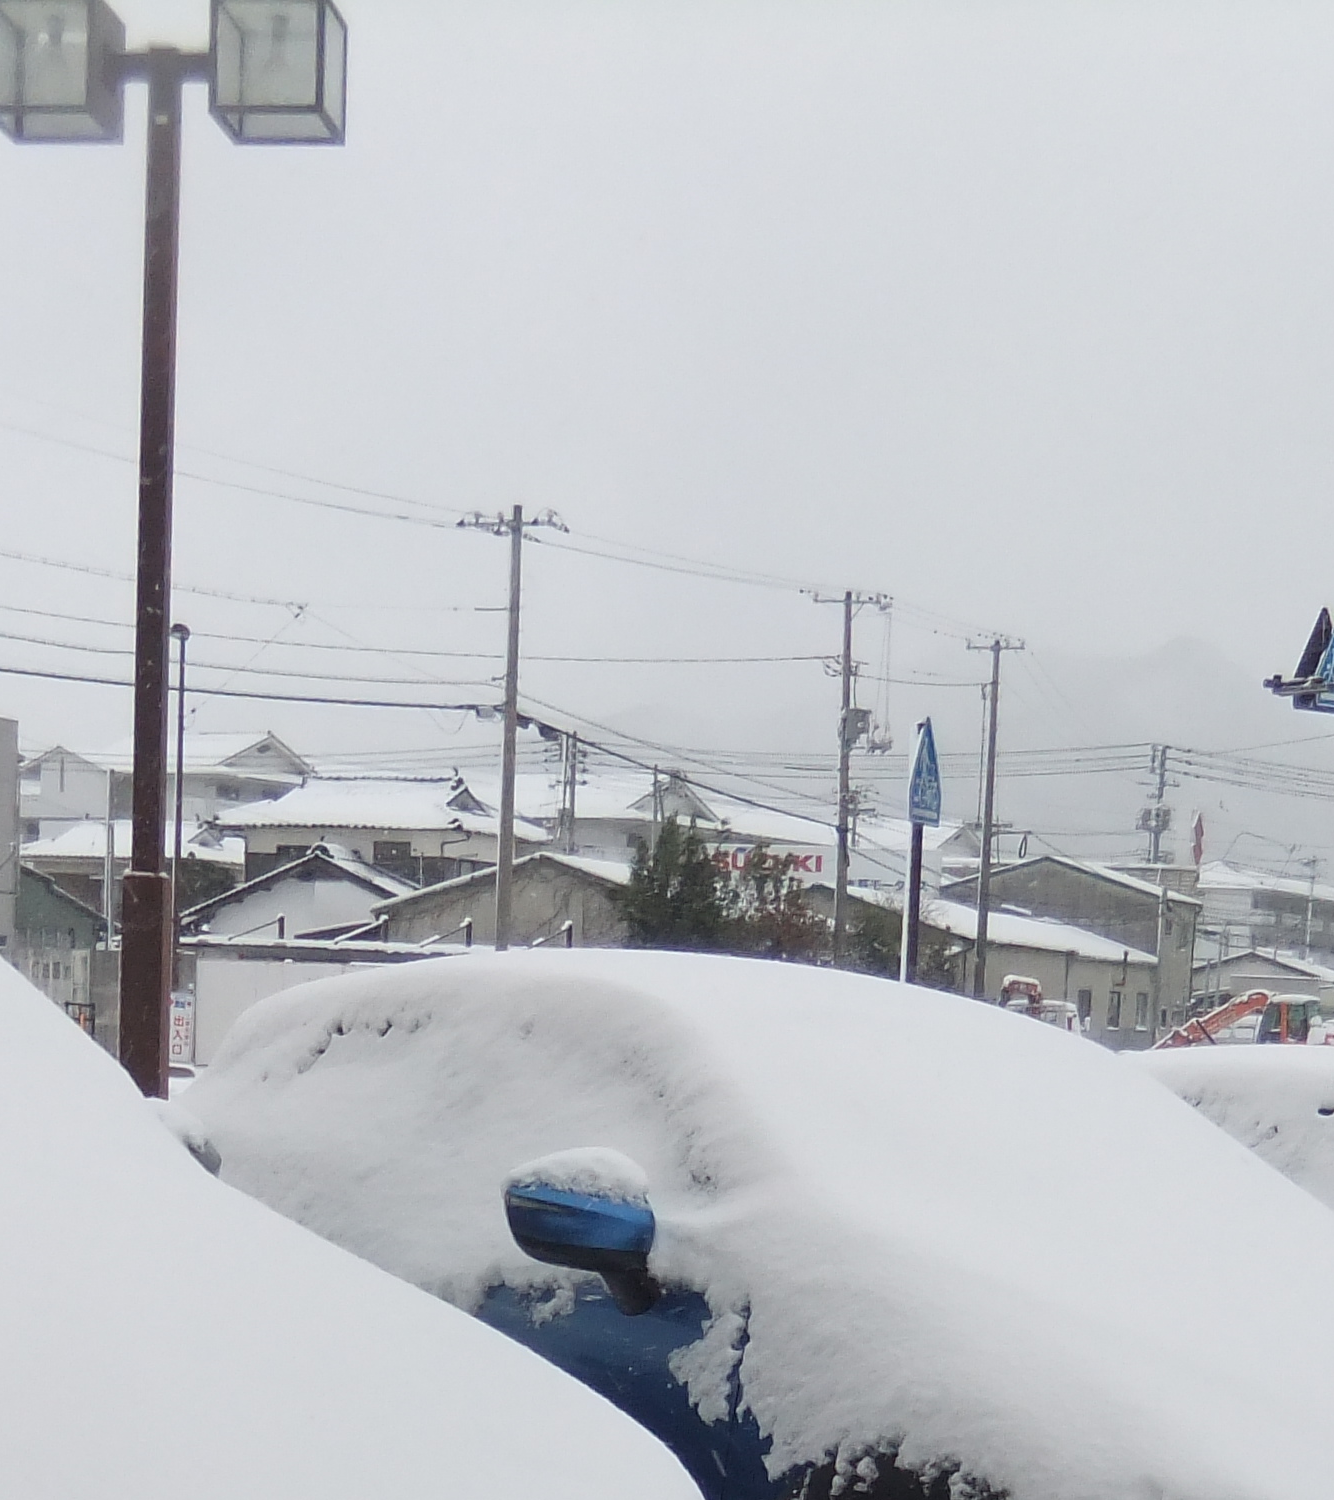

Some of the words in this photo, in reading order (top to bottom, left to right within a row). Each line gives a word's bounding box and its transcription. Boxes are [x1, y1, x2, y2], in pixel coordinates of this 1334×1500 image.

[711, 847, 824, 873] SUZKI
[172, 1015, 185, 1055] 出入口
